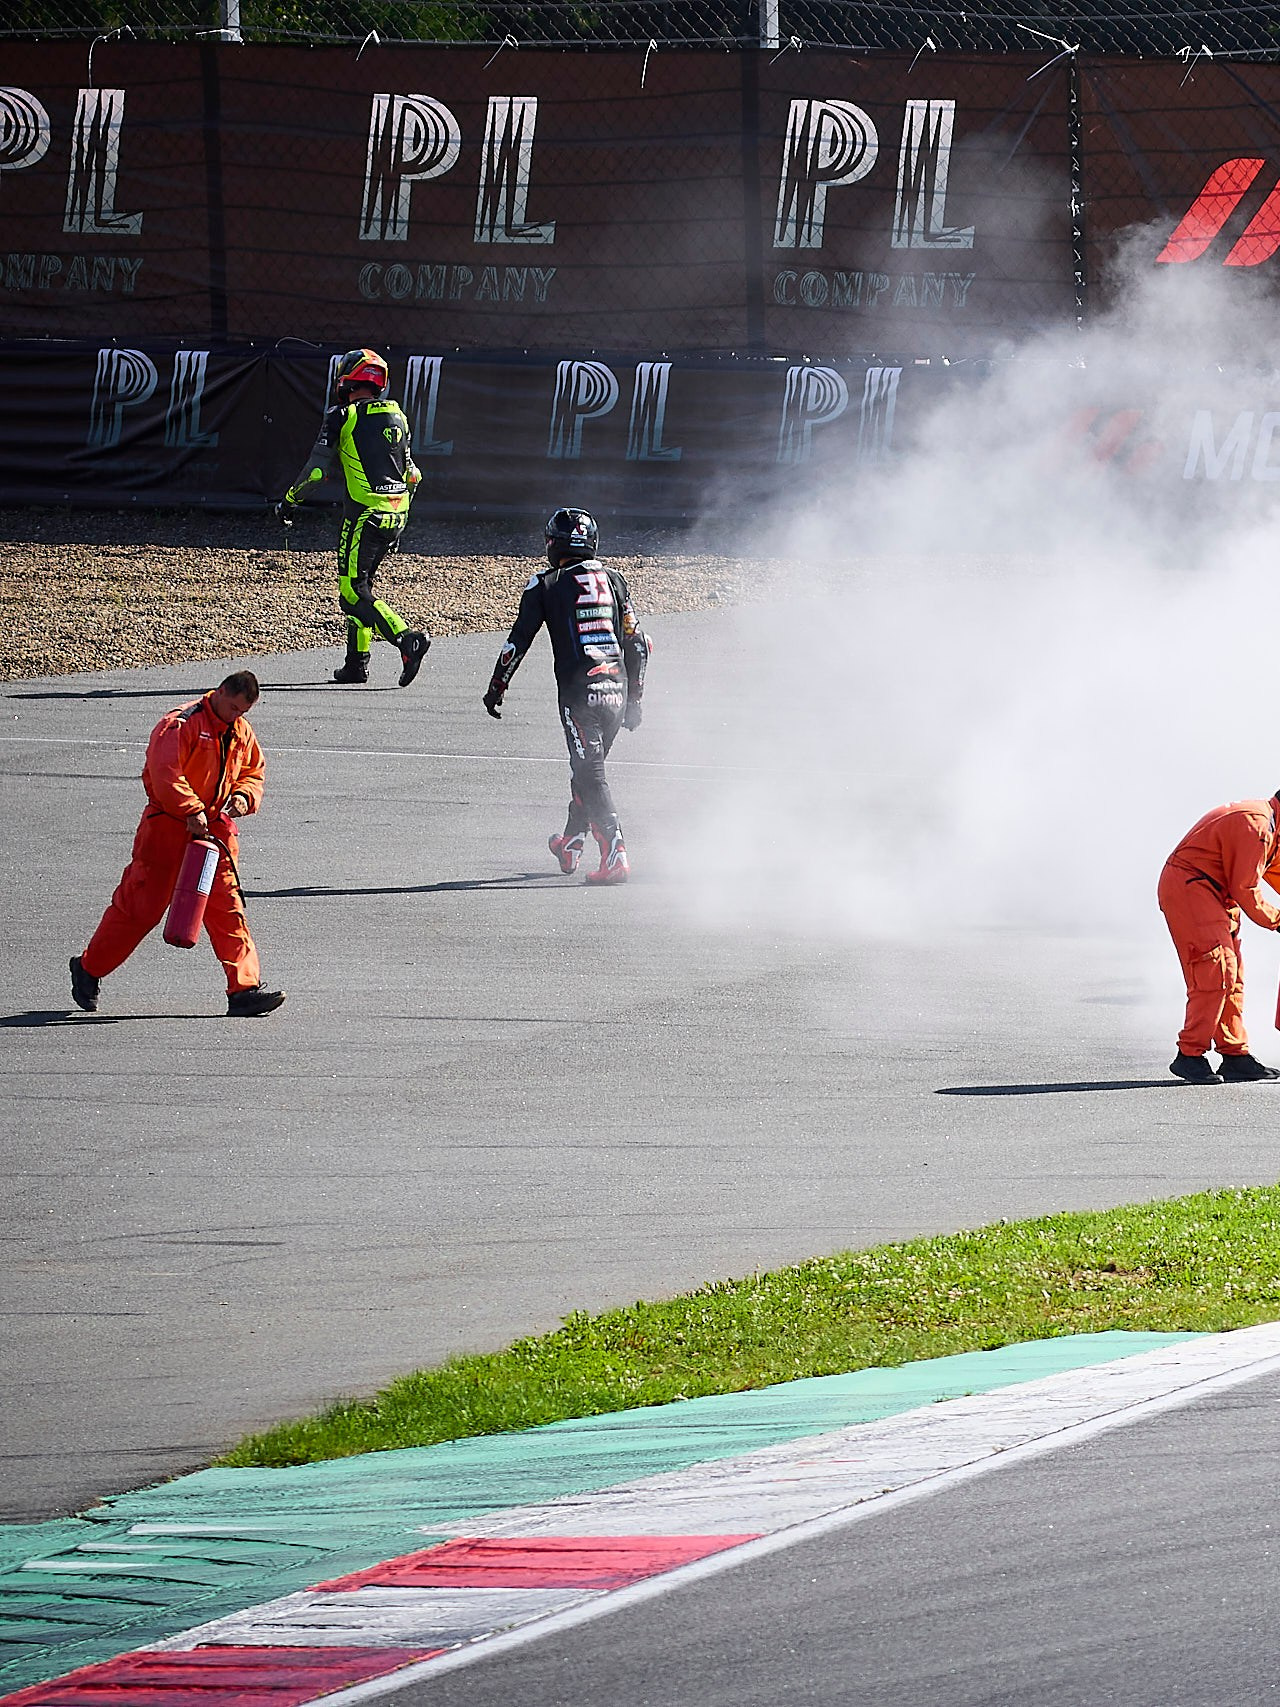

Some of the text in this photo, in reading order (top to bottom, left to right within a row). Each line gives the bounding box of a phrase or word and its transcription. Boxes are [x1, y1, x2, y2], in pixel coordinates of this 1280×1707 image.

[358, 93, 556, 244] PL
[773, 99, 976, 249] PL
[0, 253, 144, 292] MPANY
[358, 262, 558, 301] COMPANY
[773, 269, 976, 307] COMPANY
[86, 348, 219, 449] PL
[546, 360, 683, 461] PL
